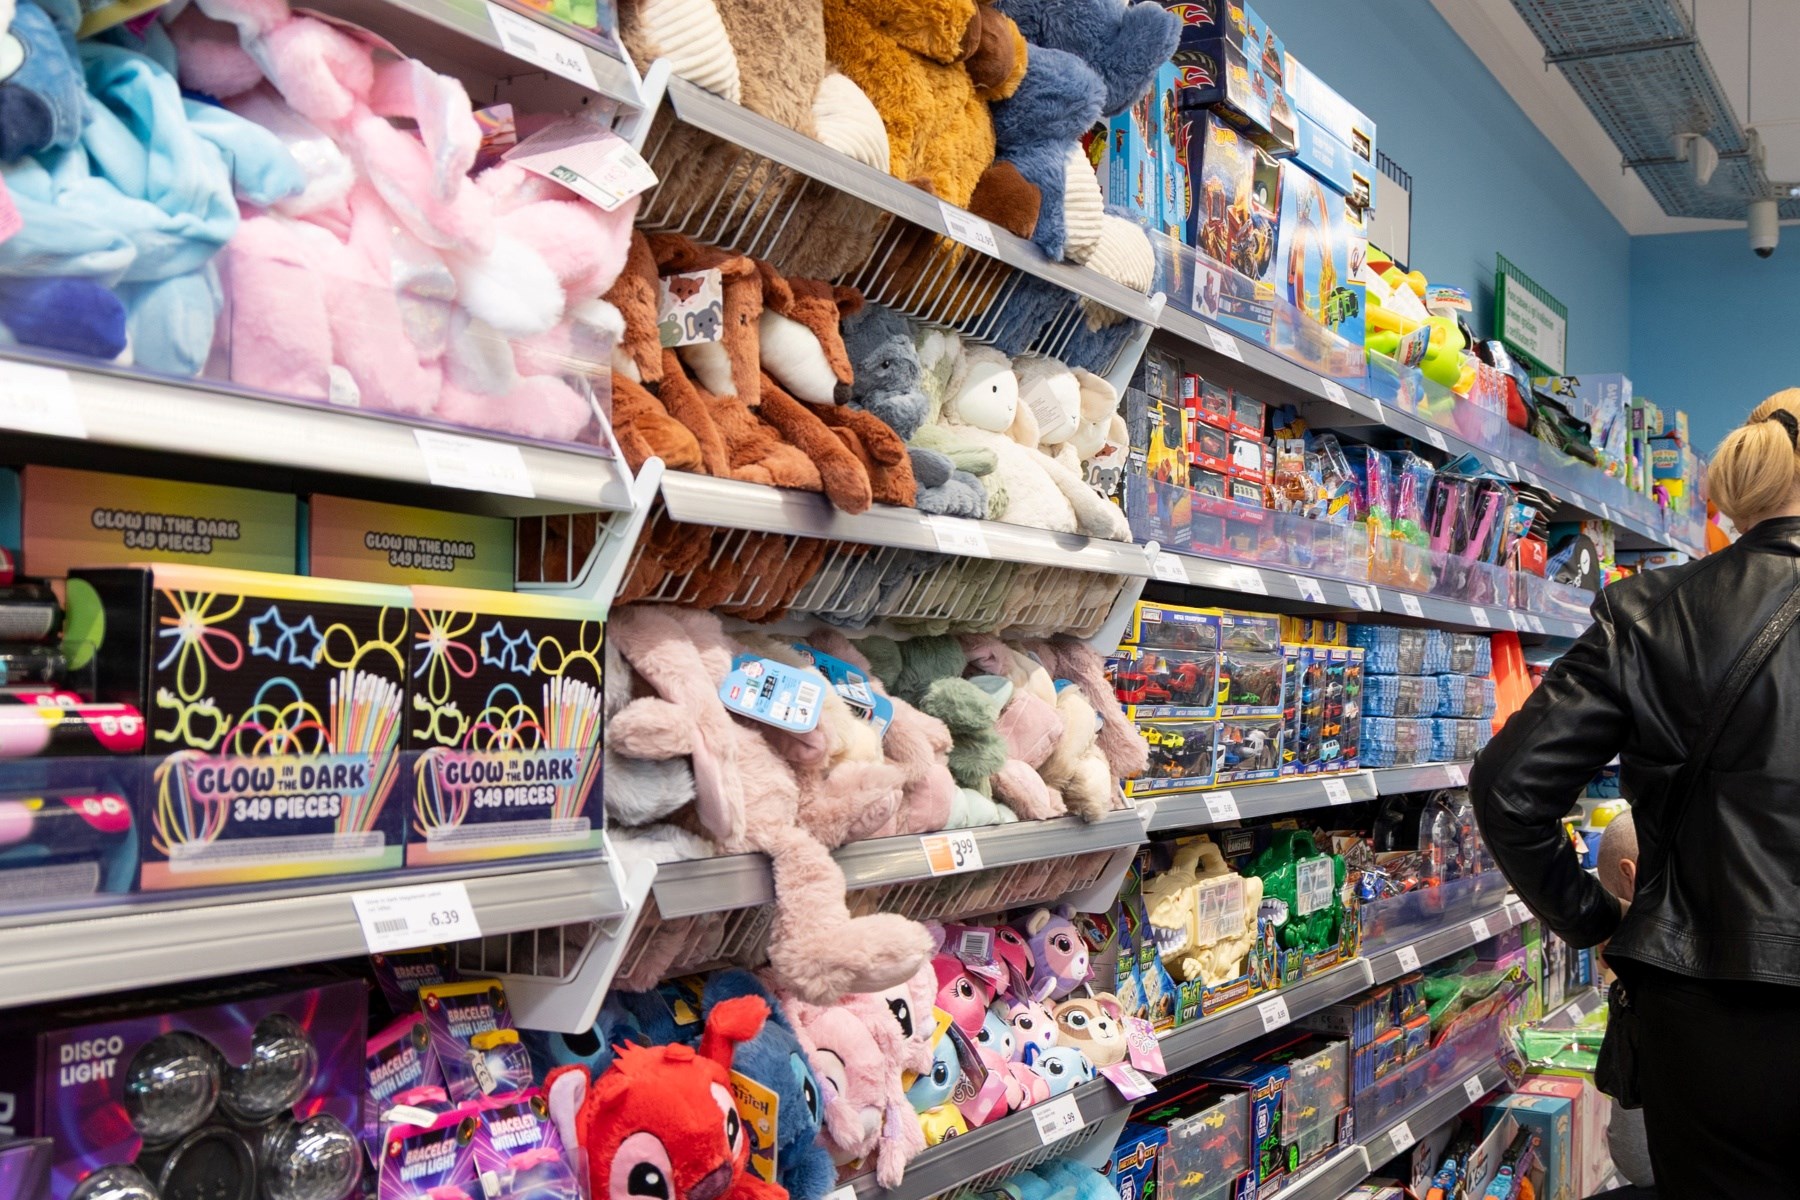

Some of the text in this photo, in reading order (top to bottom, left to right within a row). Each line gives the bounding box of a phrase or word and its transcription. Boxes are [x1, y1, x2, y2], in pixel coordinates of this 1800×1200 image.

[92, 509, 240, 539] GLOW IN THE DARK
[125, 530, 212, 553] 349 PIECES
[364, 532, 475, 558] GLOW IN THE DARK
[389, 550, 454, 571] 349 PIECES
[197, 763, 365, 794] GLOW IN THE DARK
[445, 758, 574, 784] GLOW IN THE DARK
[234, 794, 342, 821] 349 PIECES
[474, 784, 556, 808] 349 PIECES
[431, 909, 460, 926] 6.39
[394, 964, 438, 979] BRACELET
[1287, 969, 1299, 981] CITY
[448, 1005, 493, 1022] BRACELET
[1183, 1005, 1198, 1020] CITY
[448, 1018, 498, 1037] WITH LIGHT
[60, 1035, 124, 1064] DISCO
[60, 1058, 117, 1087] LIGHT
[370, 1048, 416, 1083] BRACELET
[370, 1060, 423, 1100] WITH LIGHT
[490, 1114, 537, 1135] BRACELET
[1063, 1112, 1075, 1125] 1.99
[491, 1127, 542, 1150] WITH LIGHT
[405, 1139, 456, 1164] BRACELET
[401, 1153, 457, 1181] WITH LIGHT
